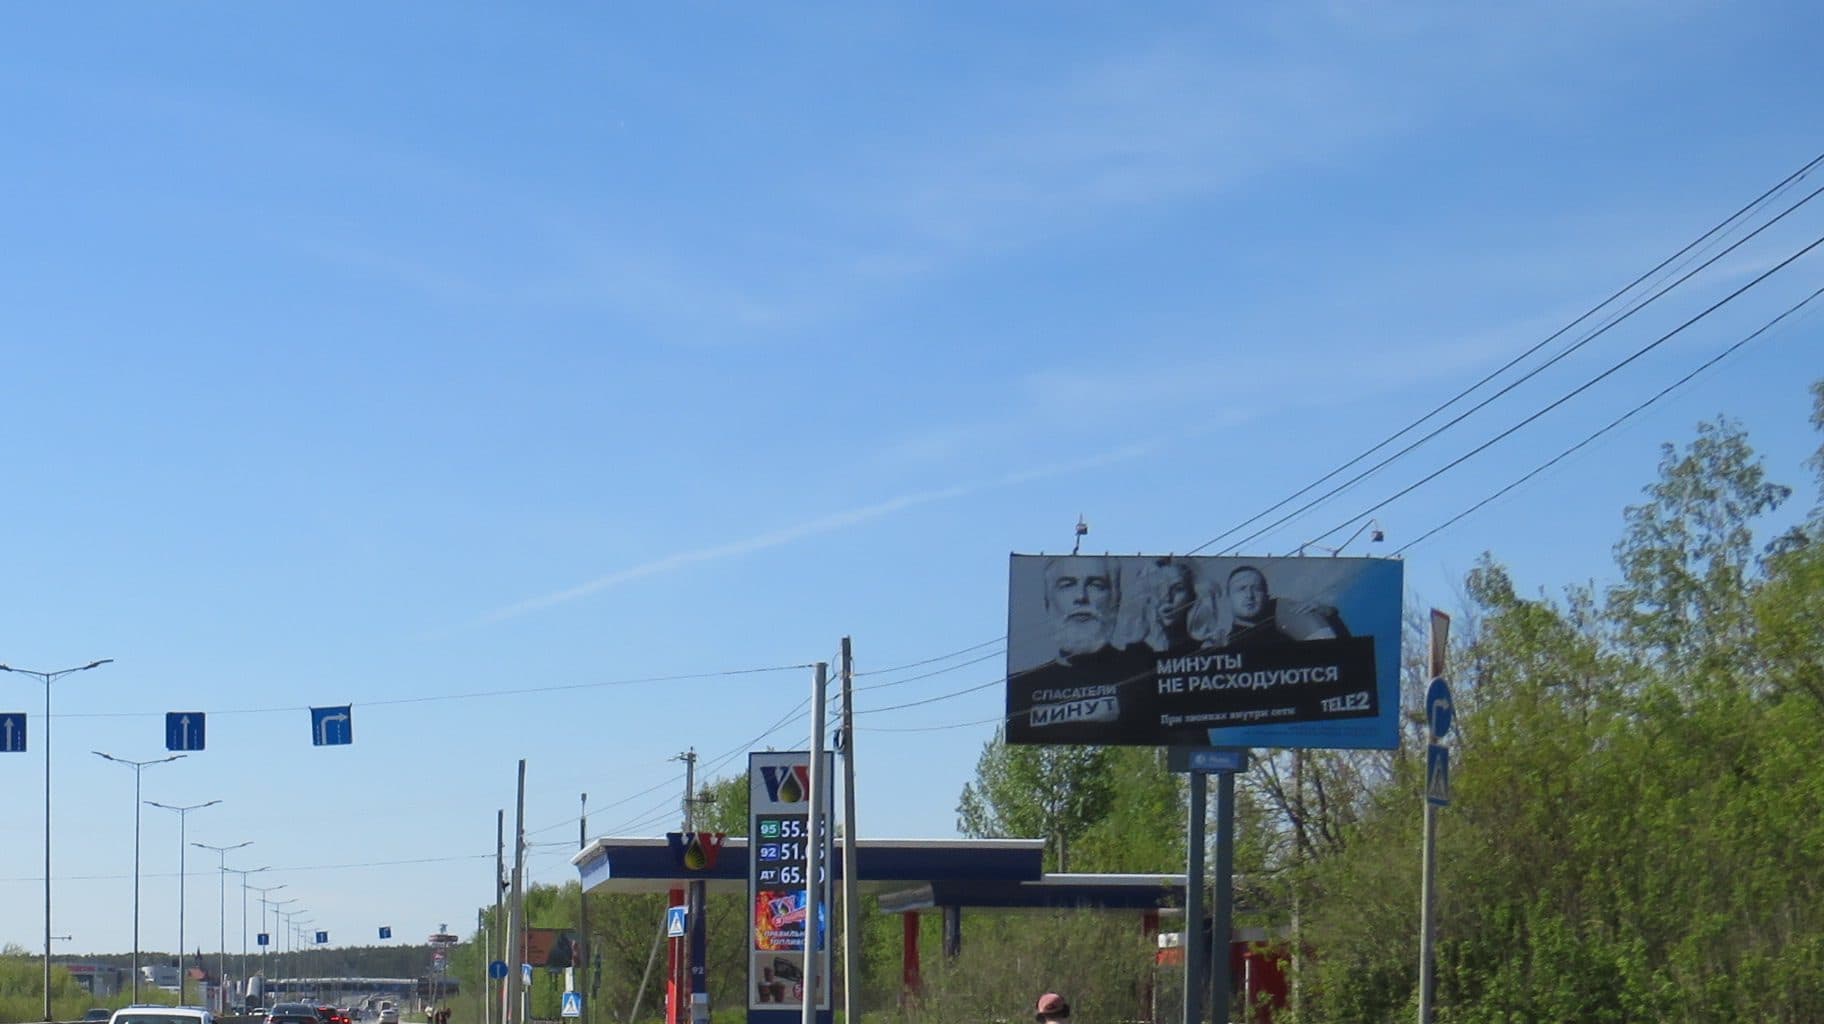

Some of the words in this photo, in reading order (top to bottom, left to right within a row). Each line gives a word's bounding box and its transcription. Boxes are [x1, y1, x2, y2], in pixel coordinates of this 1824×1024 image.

[1156, 653, 1243, 675] МИНУТЫ
[1157, 677, 1185, 694] НЕ
[1189, 665, 1339, 691] РАСХОДУЮТСЯ
[1031, 684, 1118, 701] СПАСАТЕЛИ
[1321, 691, 1370, 713] TELE2
[1031, 699, 1116, 725] МИНУТ
[760, 824, 777, 835] 95
[760, 847, 777, 858] 92
